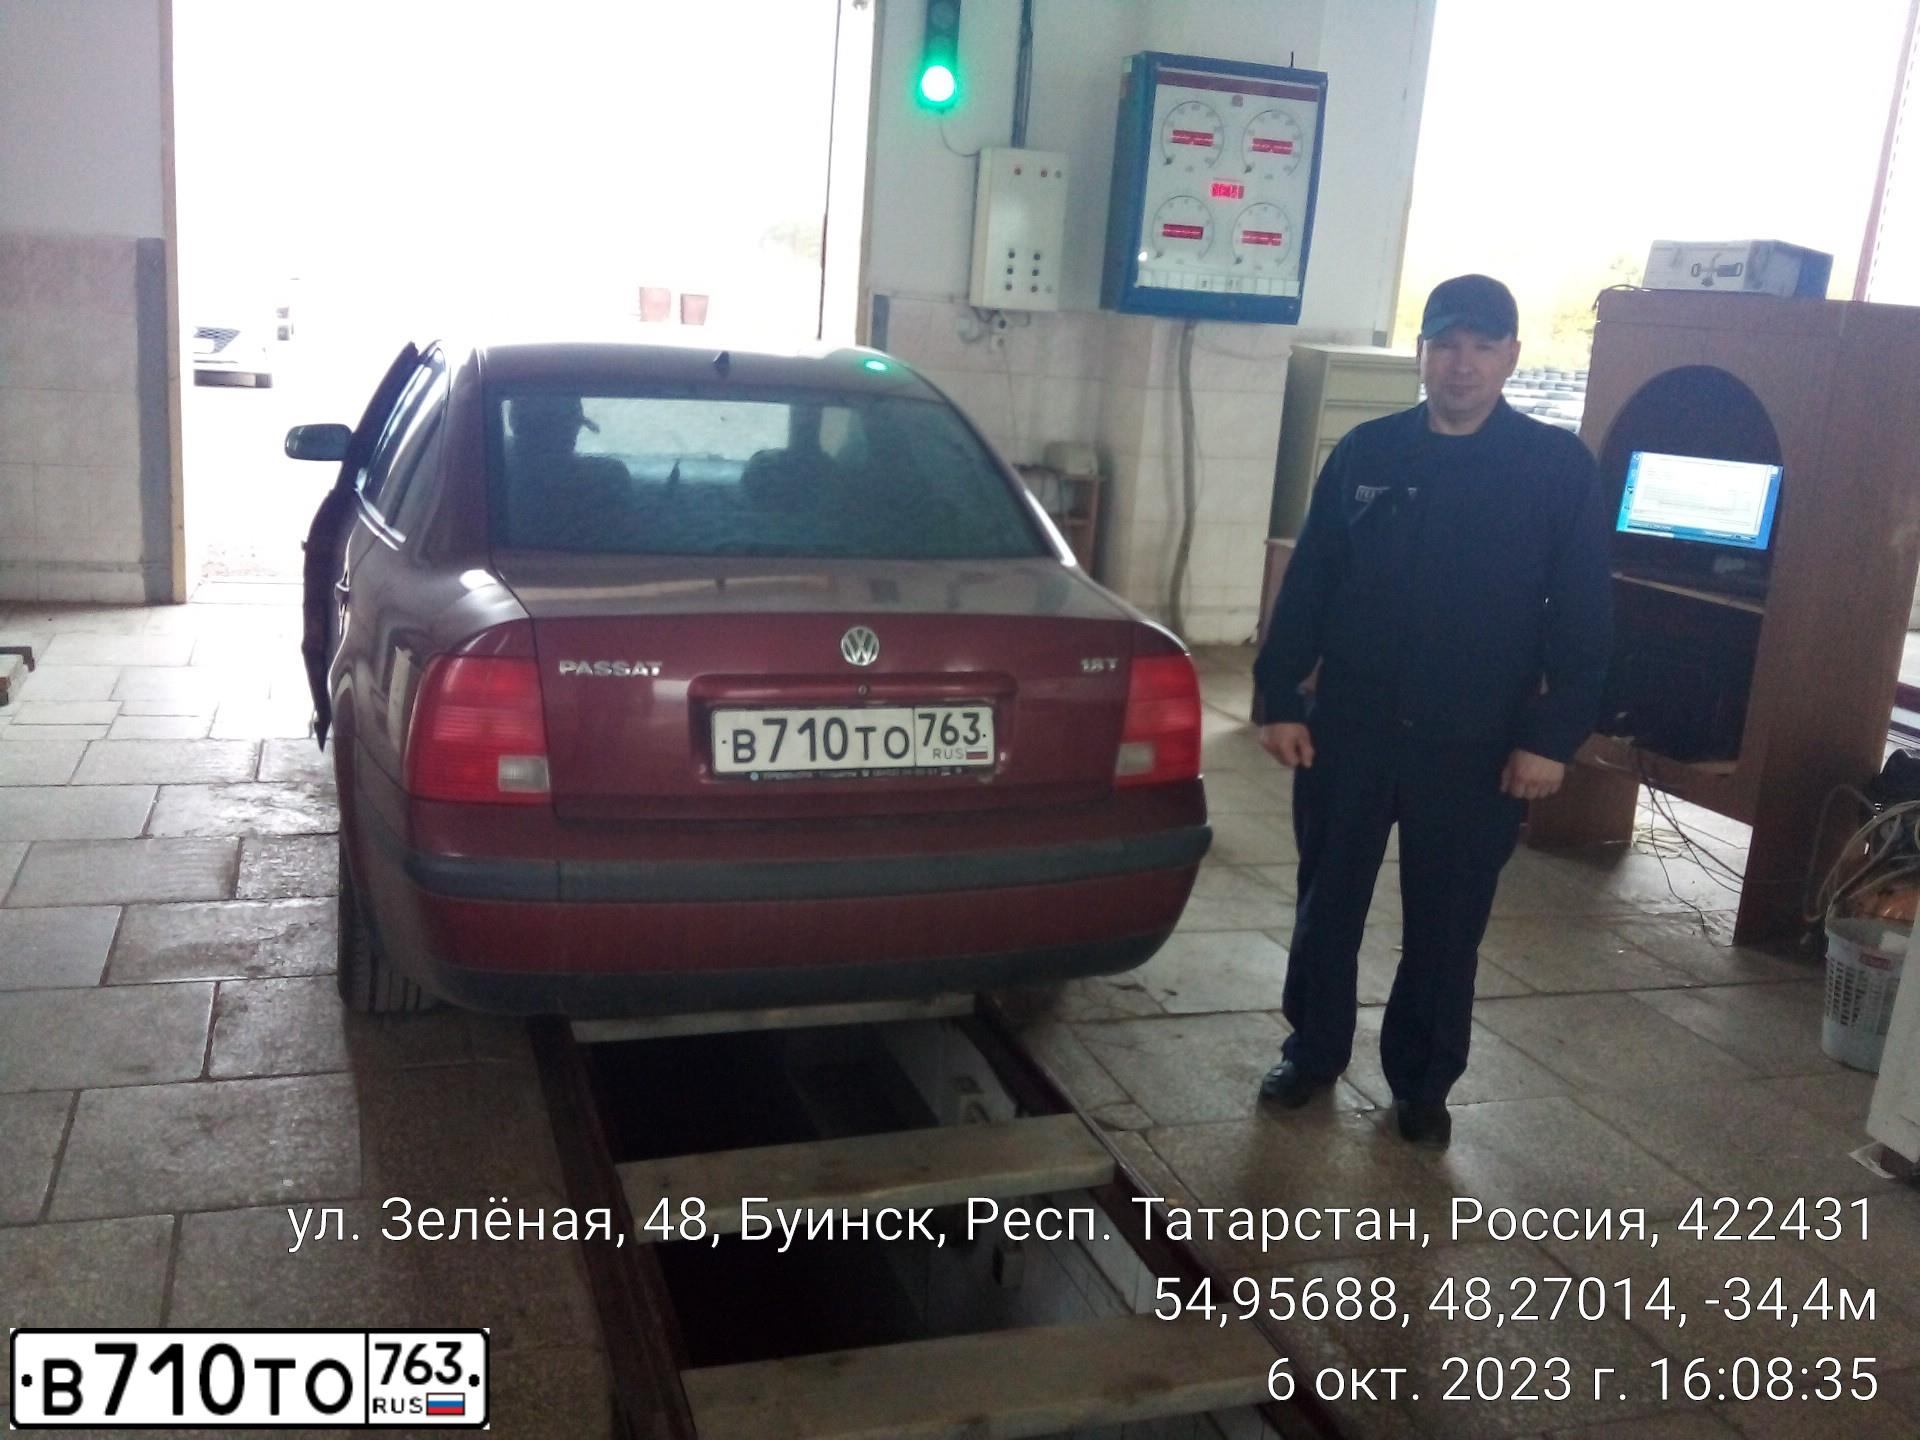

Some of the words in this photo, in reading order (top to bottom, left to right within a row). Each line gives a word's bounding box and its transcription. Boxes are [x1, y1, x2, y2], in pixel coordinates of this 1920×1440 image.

[558, 659, 663, 677] PASSAT
[917, 712, 982, 746] 763
[932, 747, 965, 760] RUS
